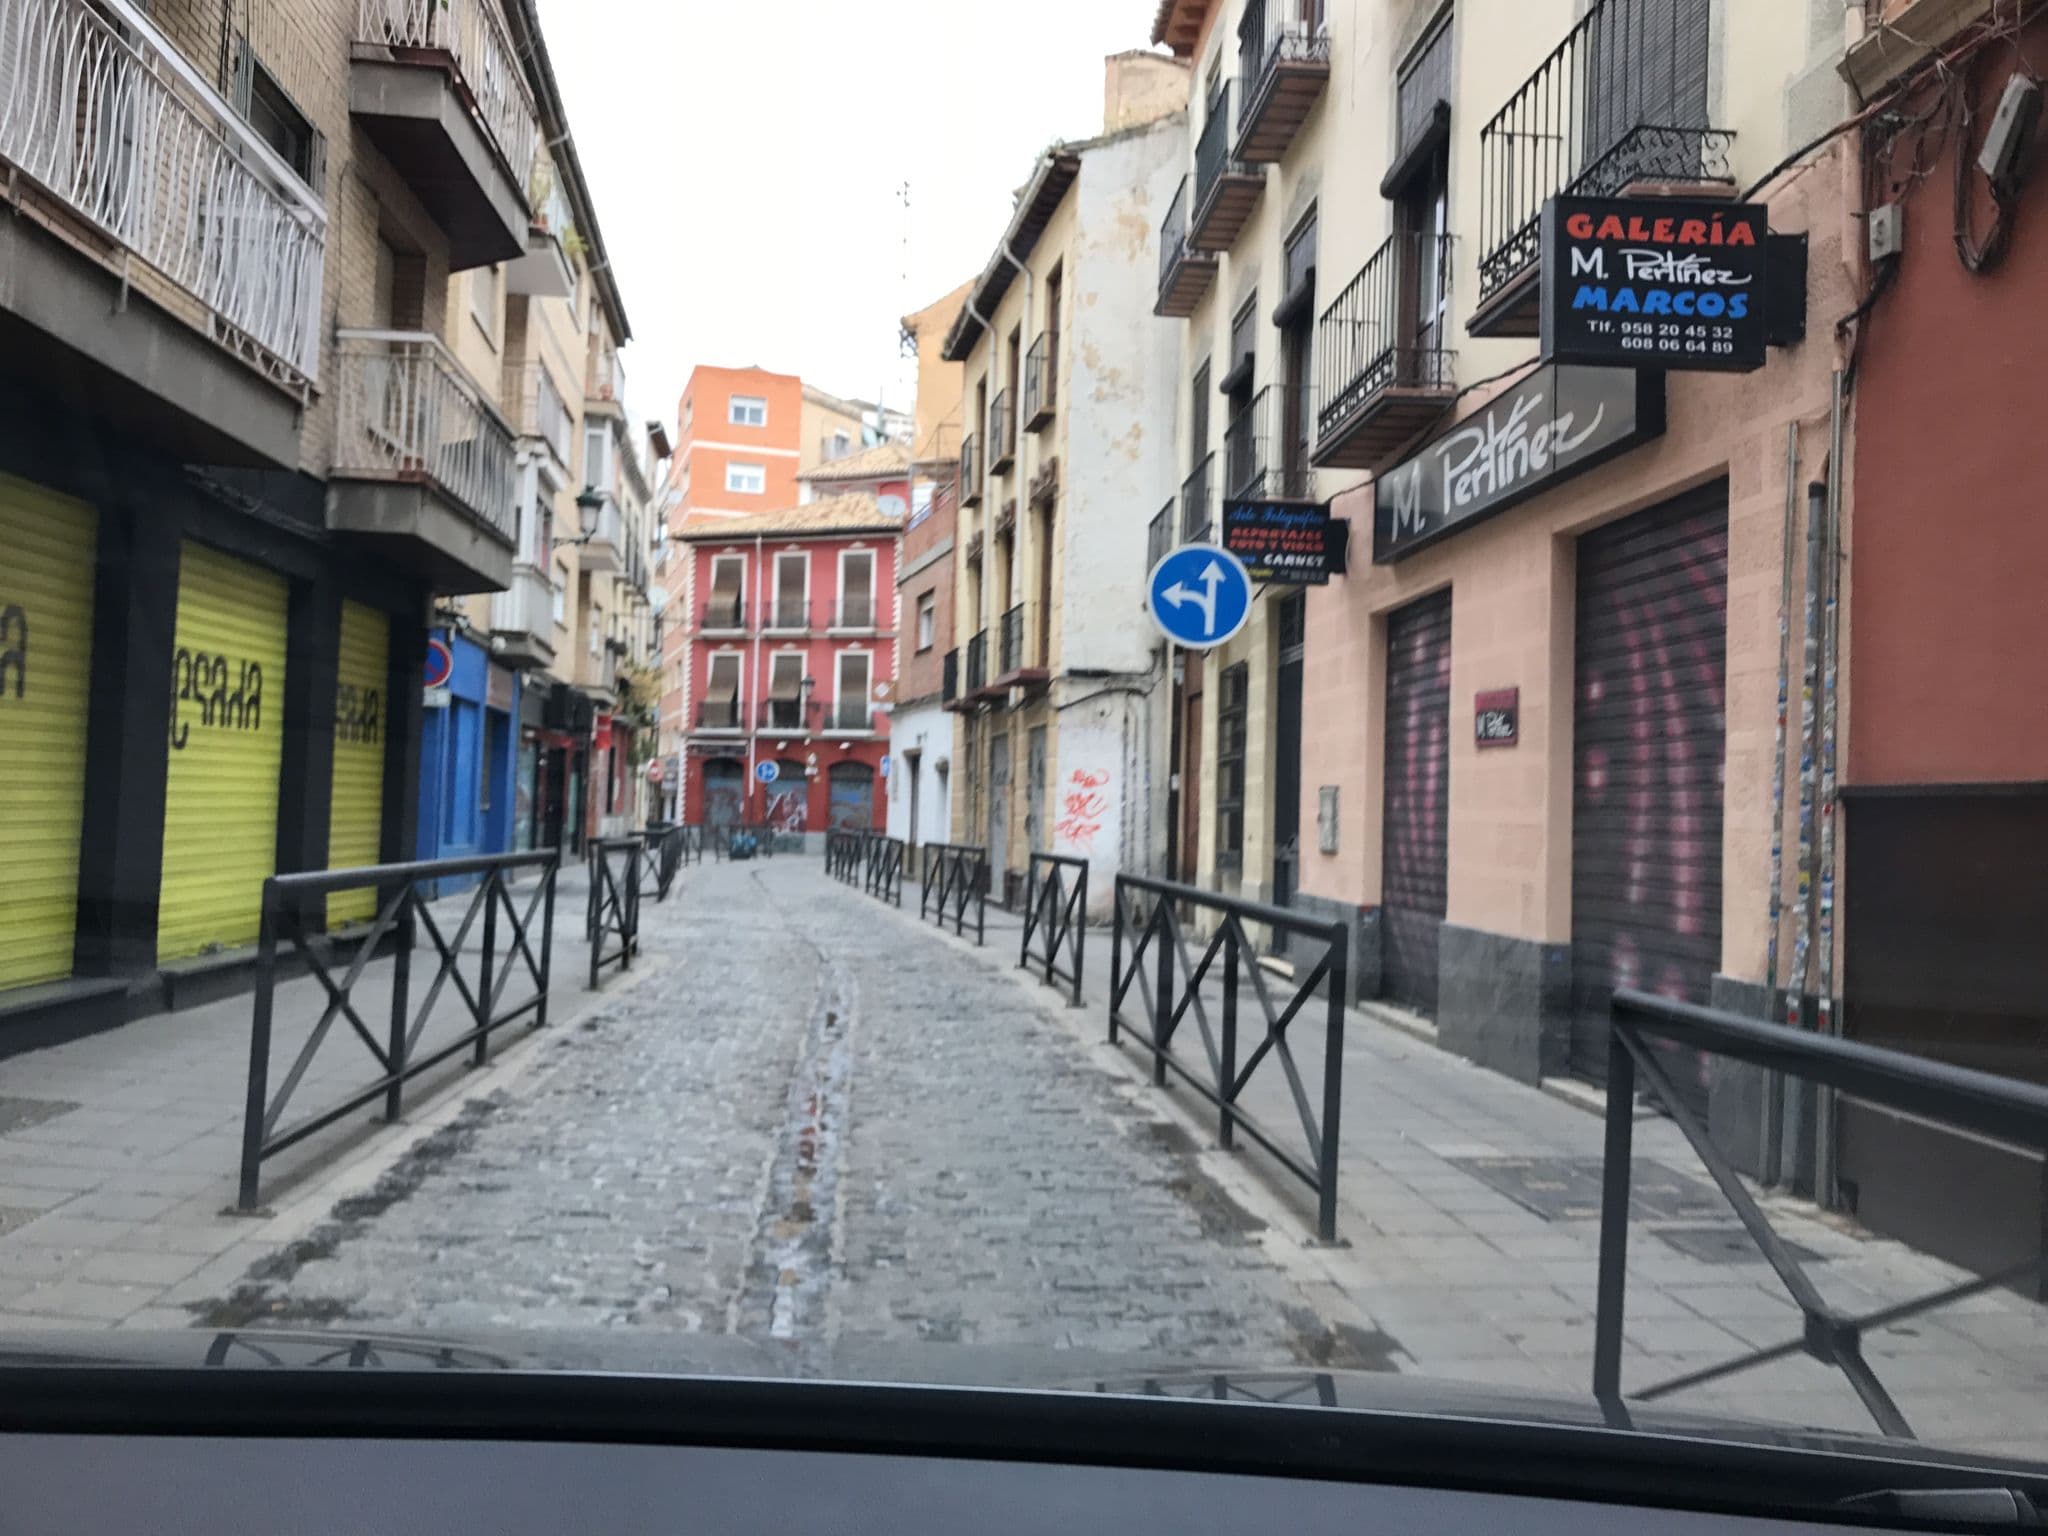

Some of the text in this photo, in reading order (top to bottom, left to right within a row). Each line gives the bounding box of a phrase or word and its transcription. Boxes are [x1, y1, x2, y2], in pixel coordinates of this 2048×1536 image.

[1567, 212, 1756, 246] GALERÍA
[1571, 246, 1610, 280] M.
[1571, 285, 1749, 319] MARCOS
[1587, 320, 1733, 339] Tlf. 958 20 45 32
[1621, 337, 1733, 354] 608 06 64 89
[1263, 553, 1326, 568] CARNET
